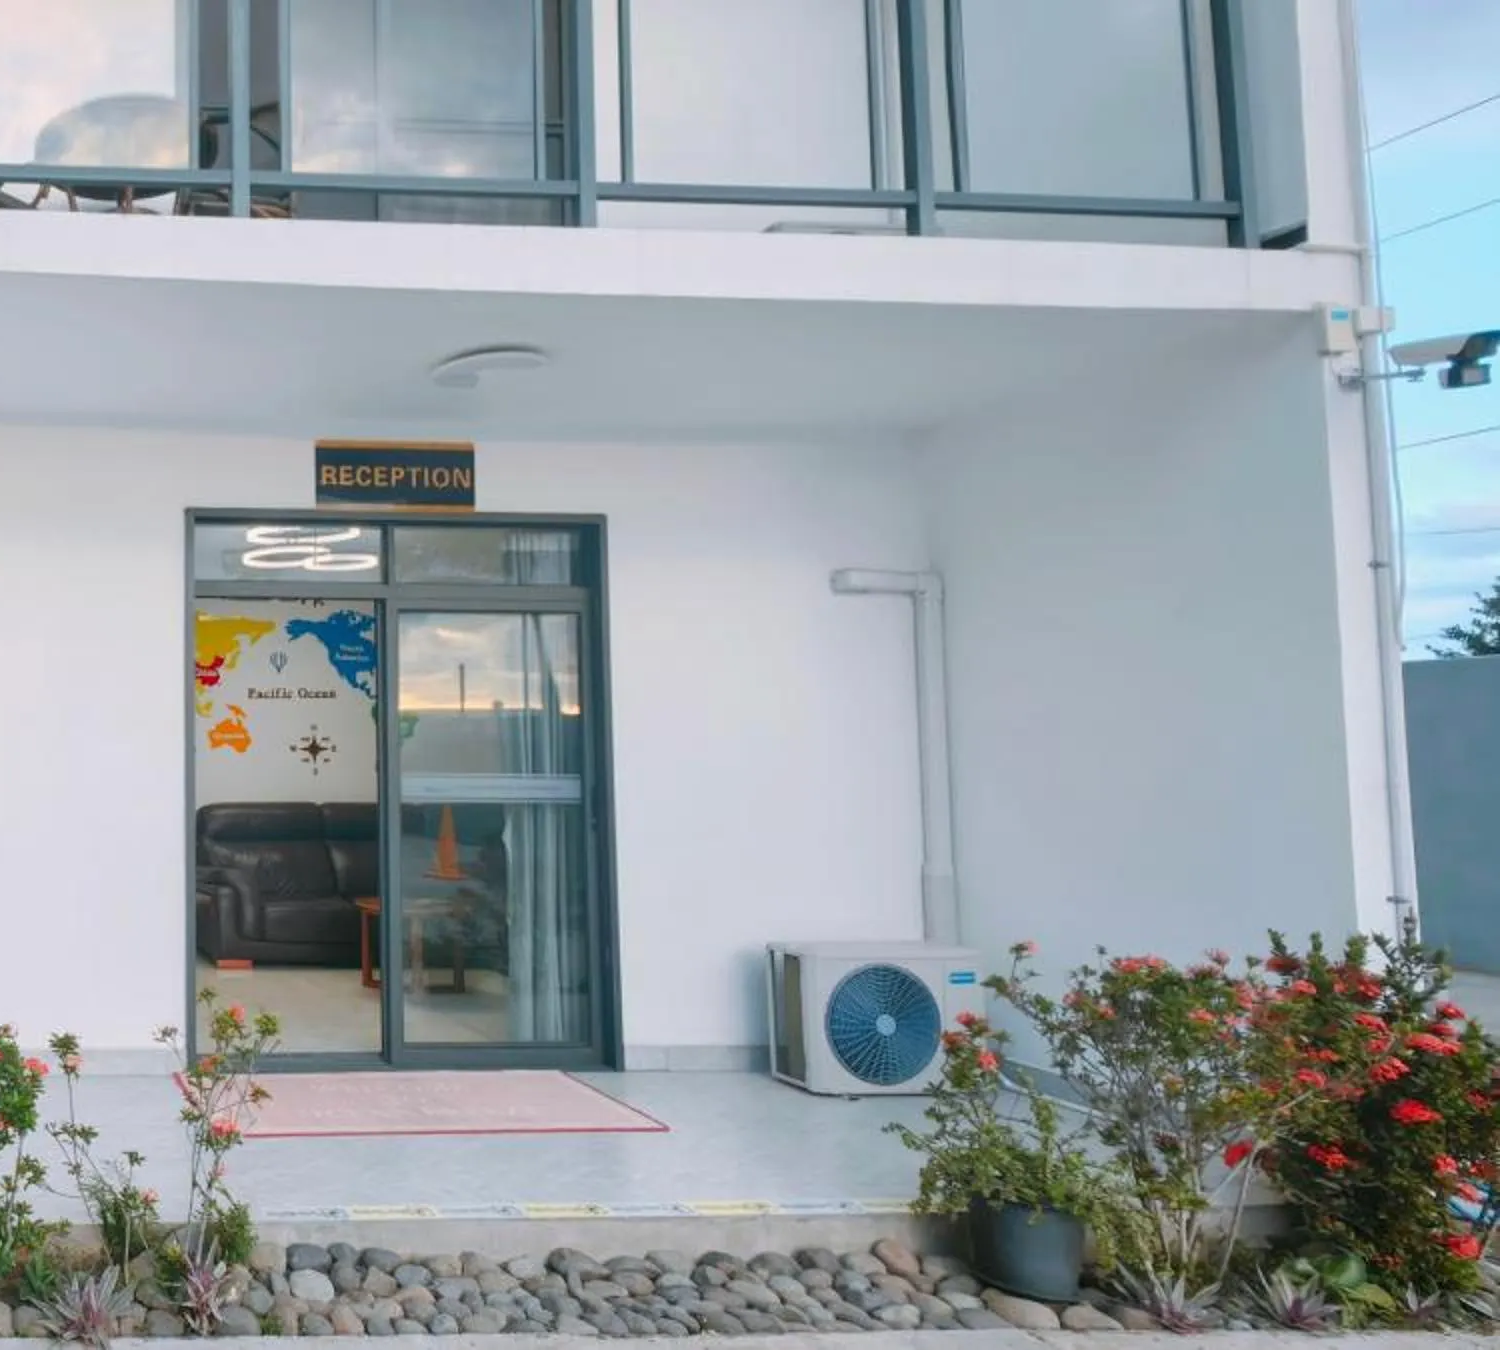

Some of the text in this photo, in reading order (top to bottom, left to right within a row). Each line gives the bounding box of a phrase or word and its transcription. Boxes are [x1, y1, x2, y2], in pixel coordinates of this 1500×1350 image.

[320, 464, 472, 489] RECEPTION
[247, 687, 337, 699] Pacific Ocean
